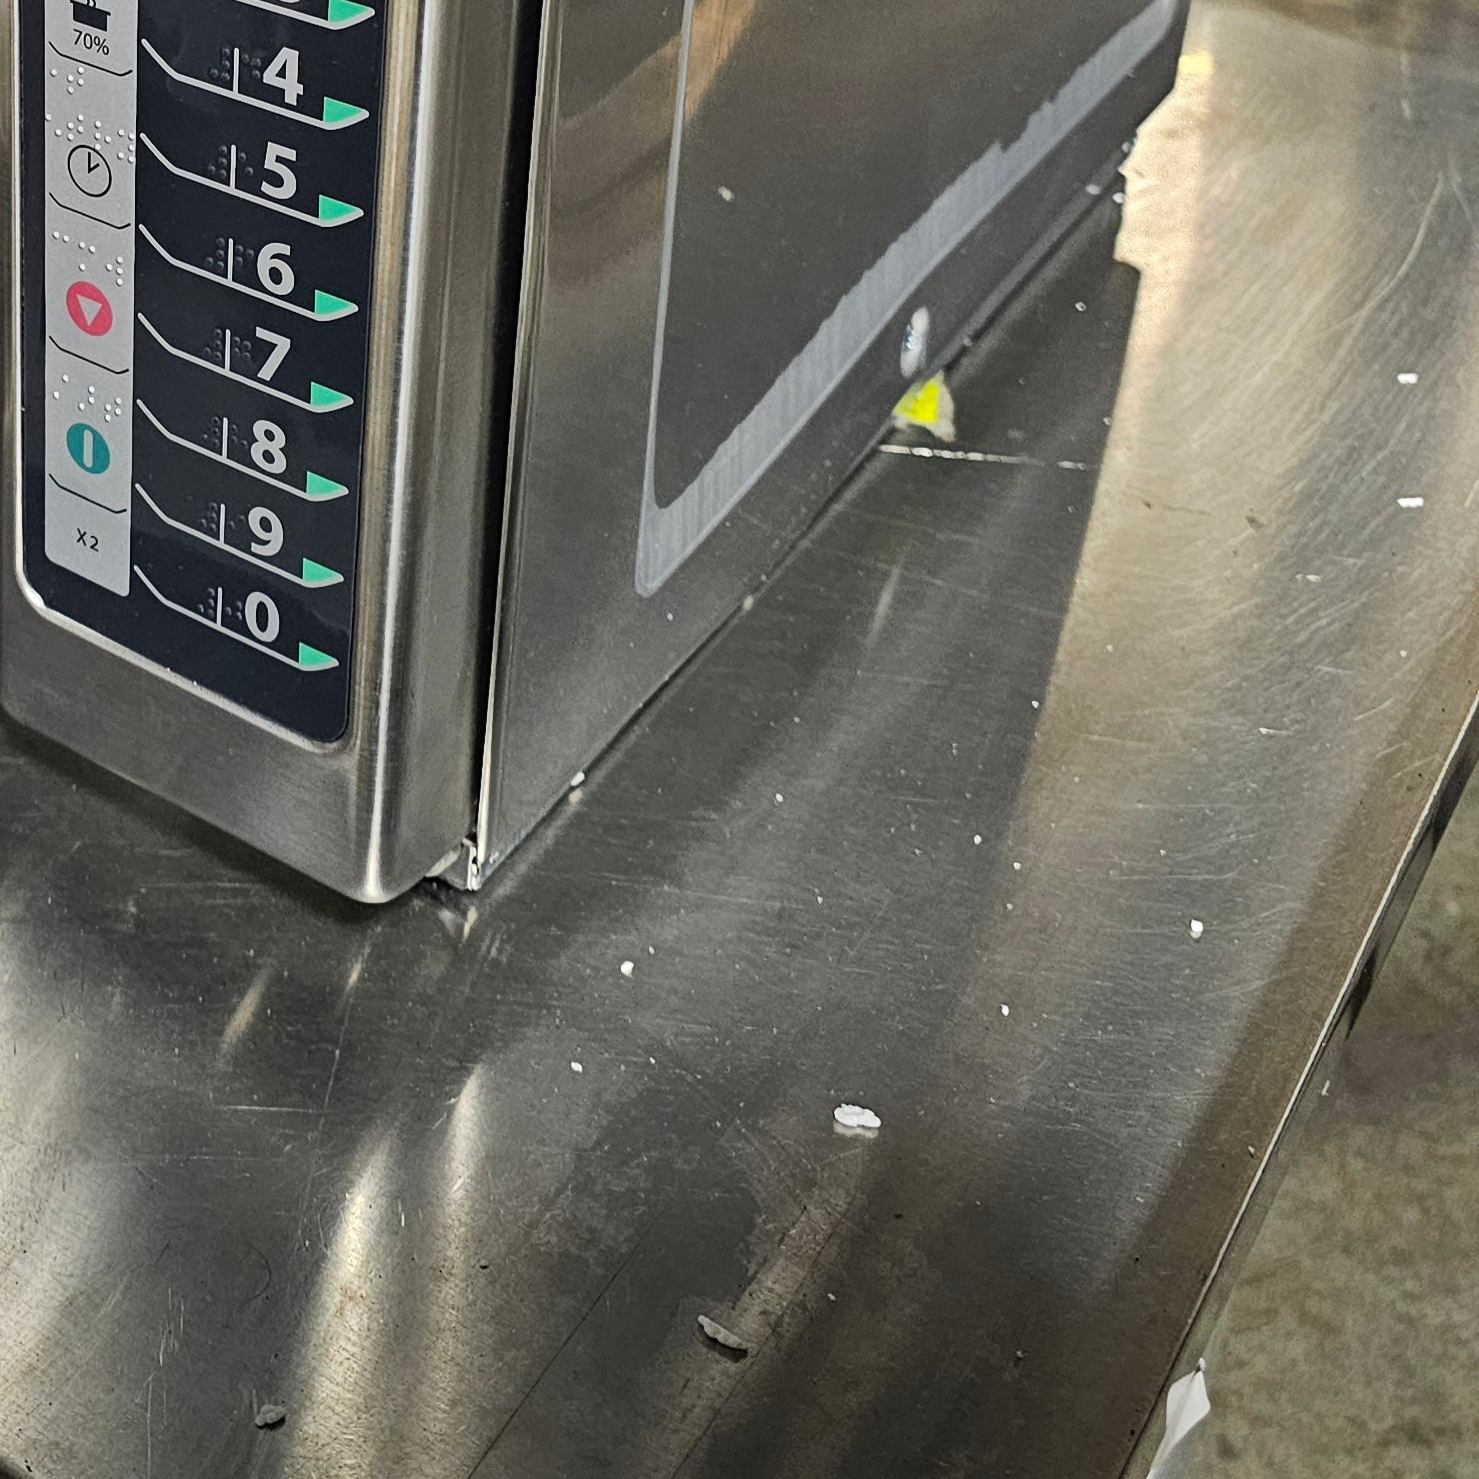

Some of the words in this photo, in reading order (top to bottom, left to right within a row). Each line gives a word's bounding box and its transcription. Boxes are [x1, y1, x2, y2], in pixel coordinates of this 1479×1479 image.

[73, 27, 110, 56] 70%
[263, 46, 304, 106] 4
[260, 141, 297, 199] 5
[256, 242, 295, 296] 6
[255, 326, 291, 381] 7
[250, 420, 287, 474] 8
[248, 506, 284, 556] 9
[244, 591, 280, 643] 0
